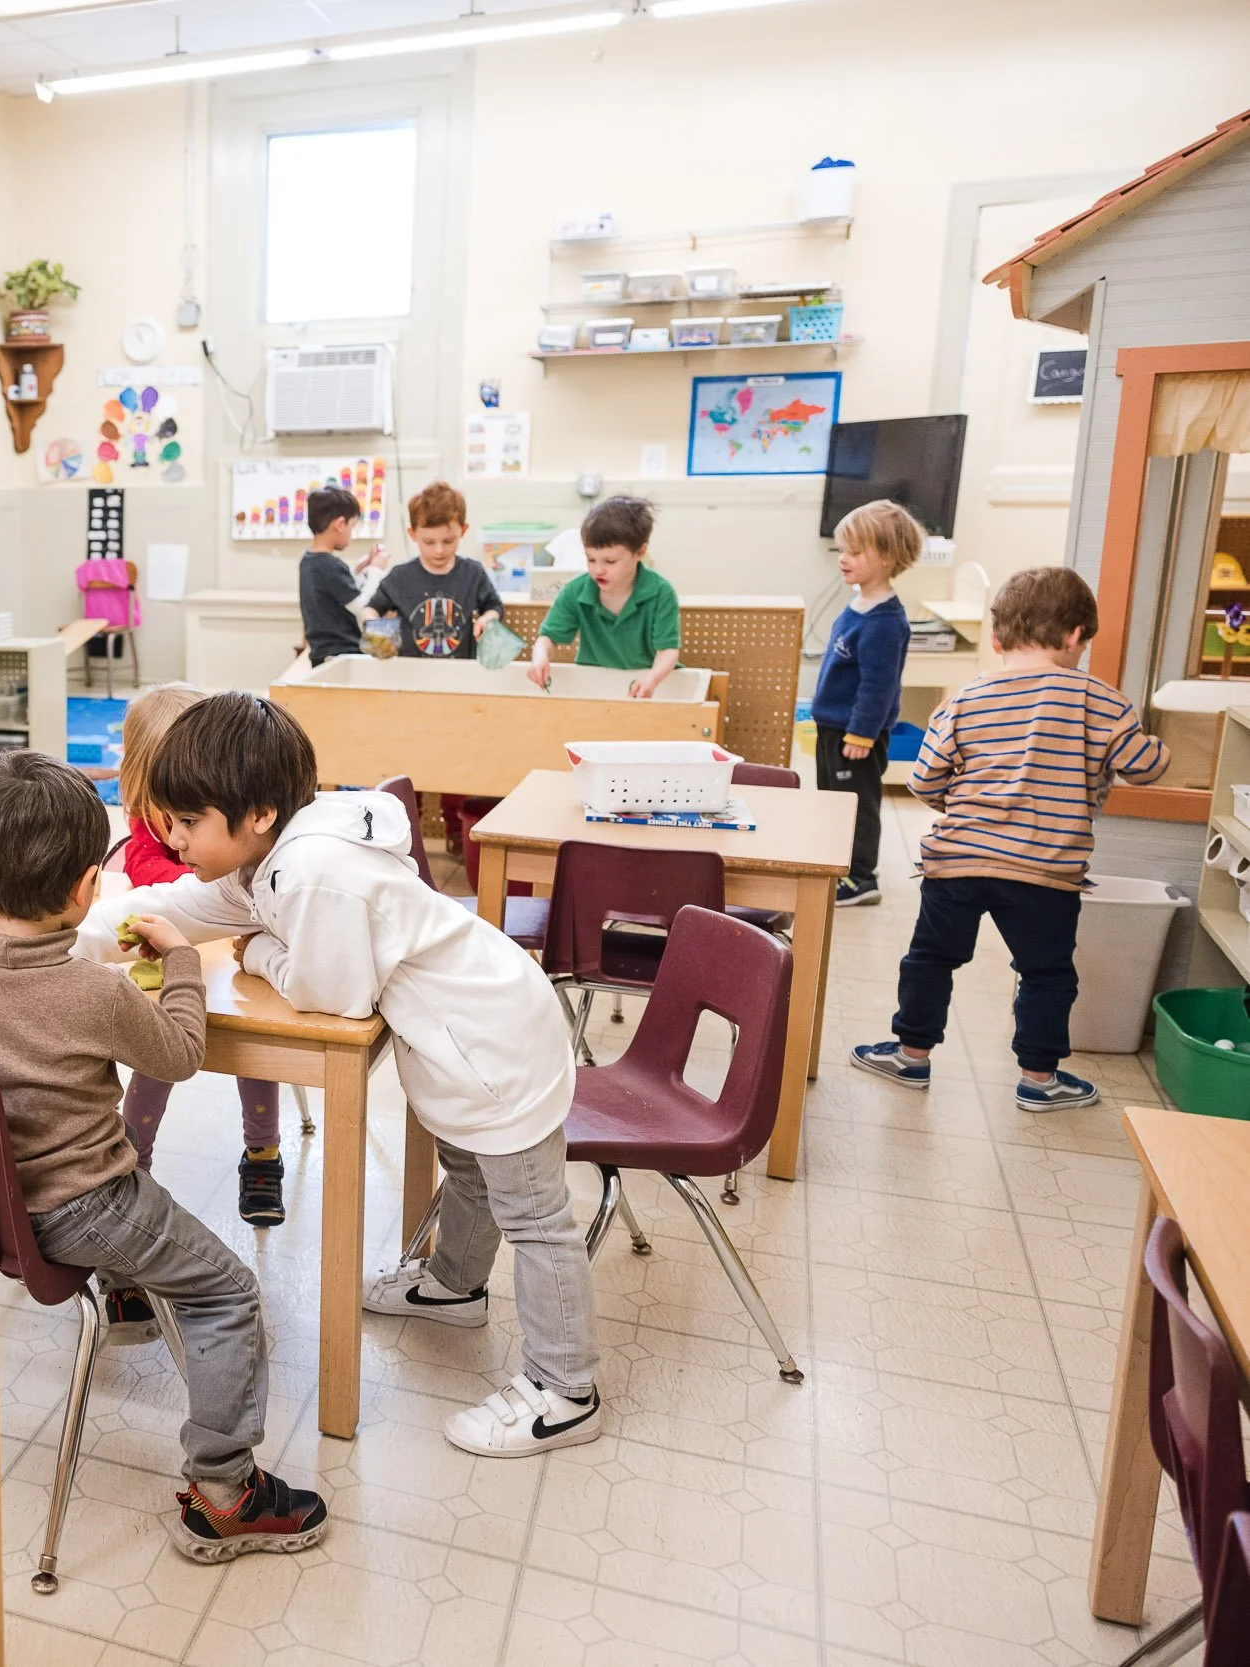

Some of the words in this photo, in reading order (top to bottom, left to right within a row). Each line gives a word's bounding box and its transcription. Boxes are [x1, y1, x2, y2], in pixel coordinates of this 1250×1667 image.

[647, 818, 677, 827] ENGINES
[677, 820, 693, 828] THE
[693, 821, 713, 829] MEET
